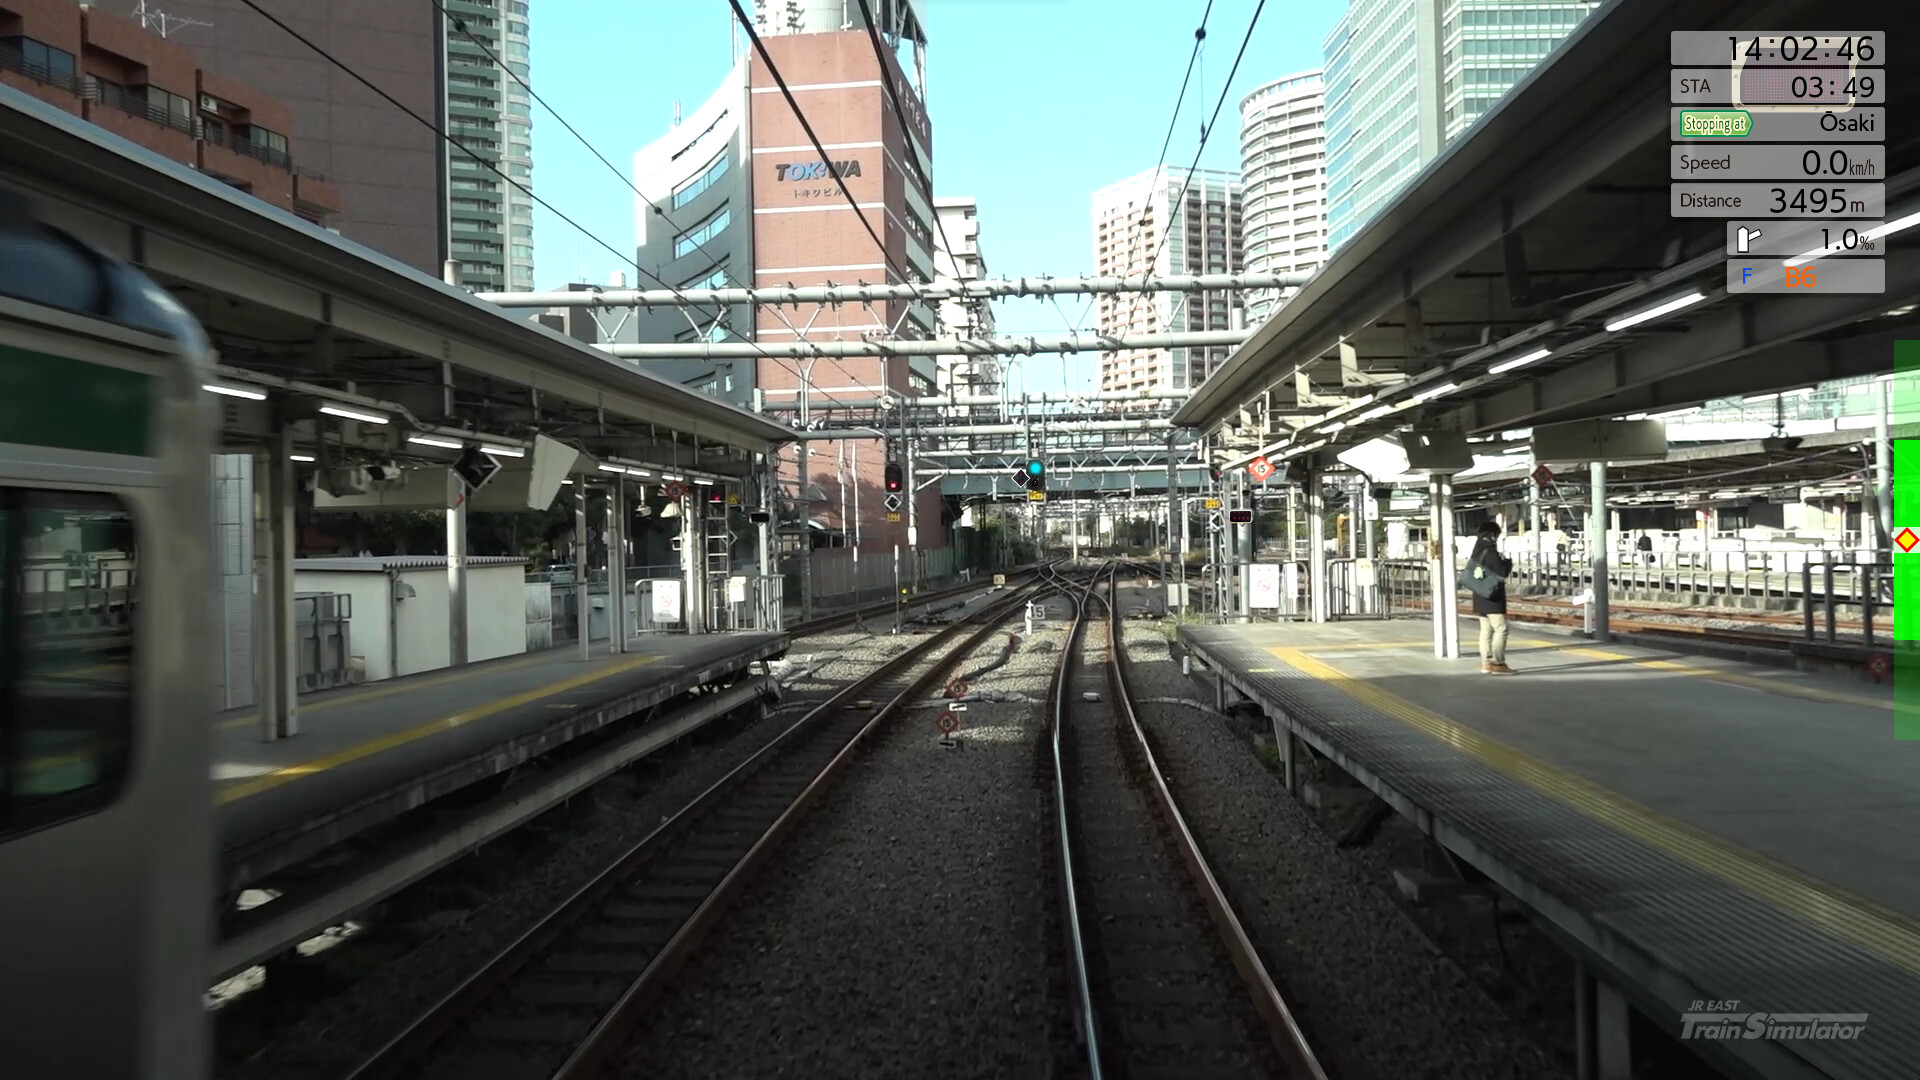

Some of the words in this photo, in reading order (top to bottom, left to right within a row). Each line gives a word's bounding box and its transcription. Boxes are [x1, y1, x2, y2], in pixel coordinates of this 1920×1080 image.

[1258, 464, 1266, 474] 15
[953, 684, 962, 693] 15
[942, 718, 951, 728] 15
